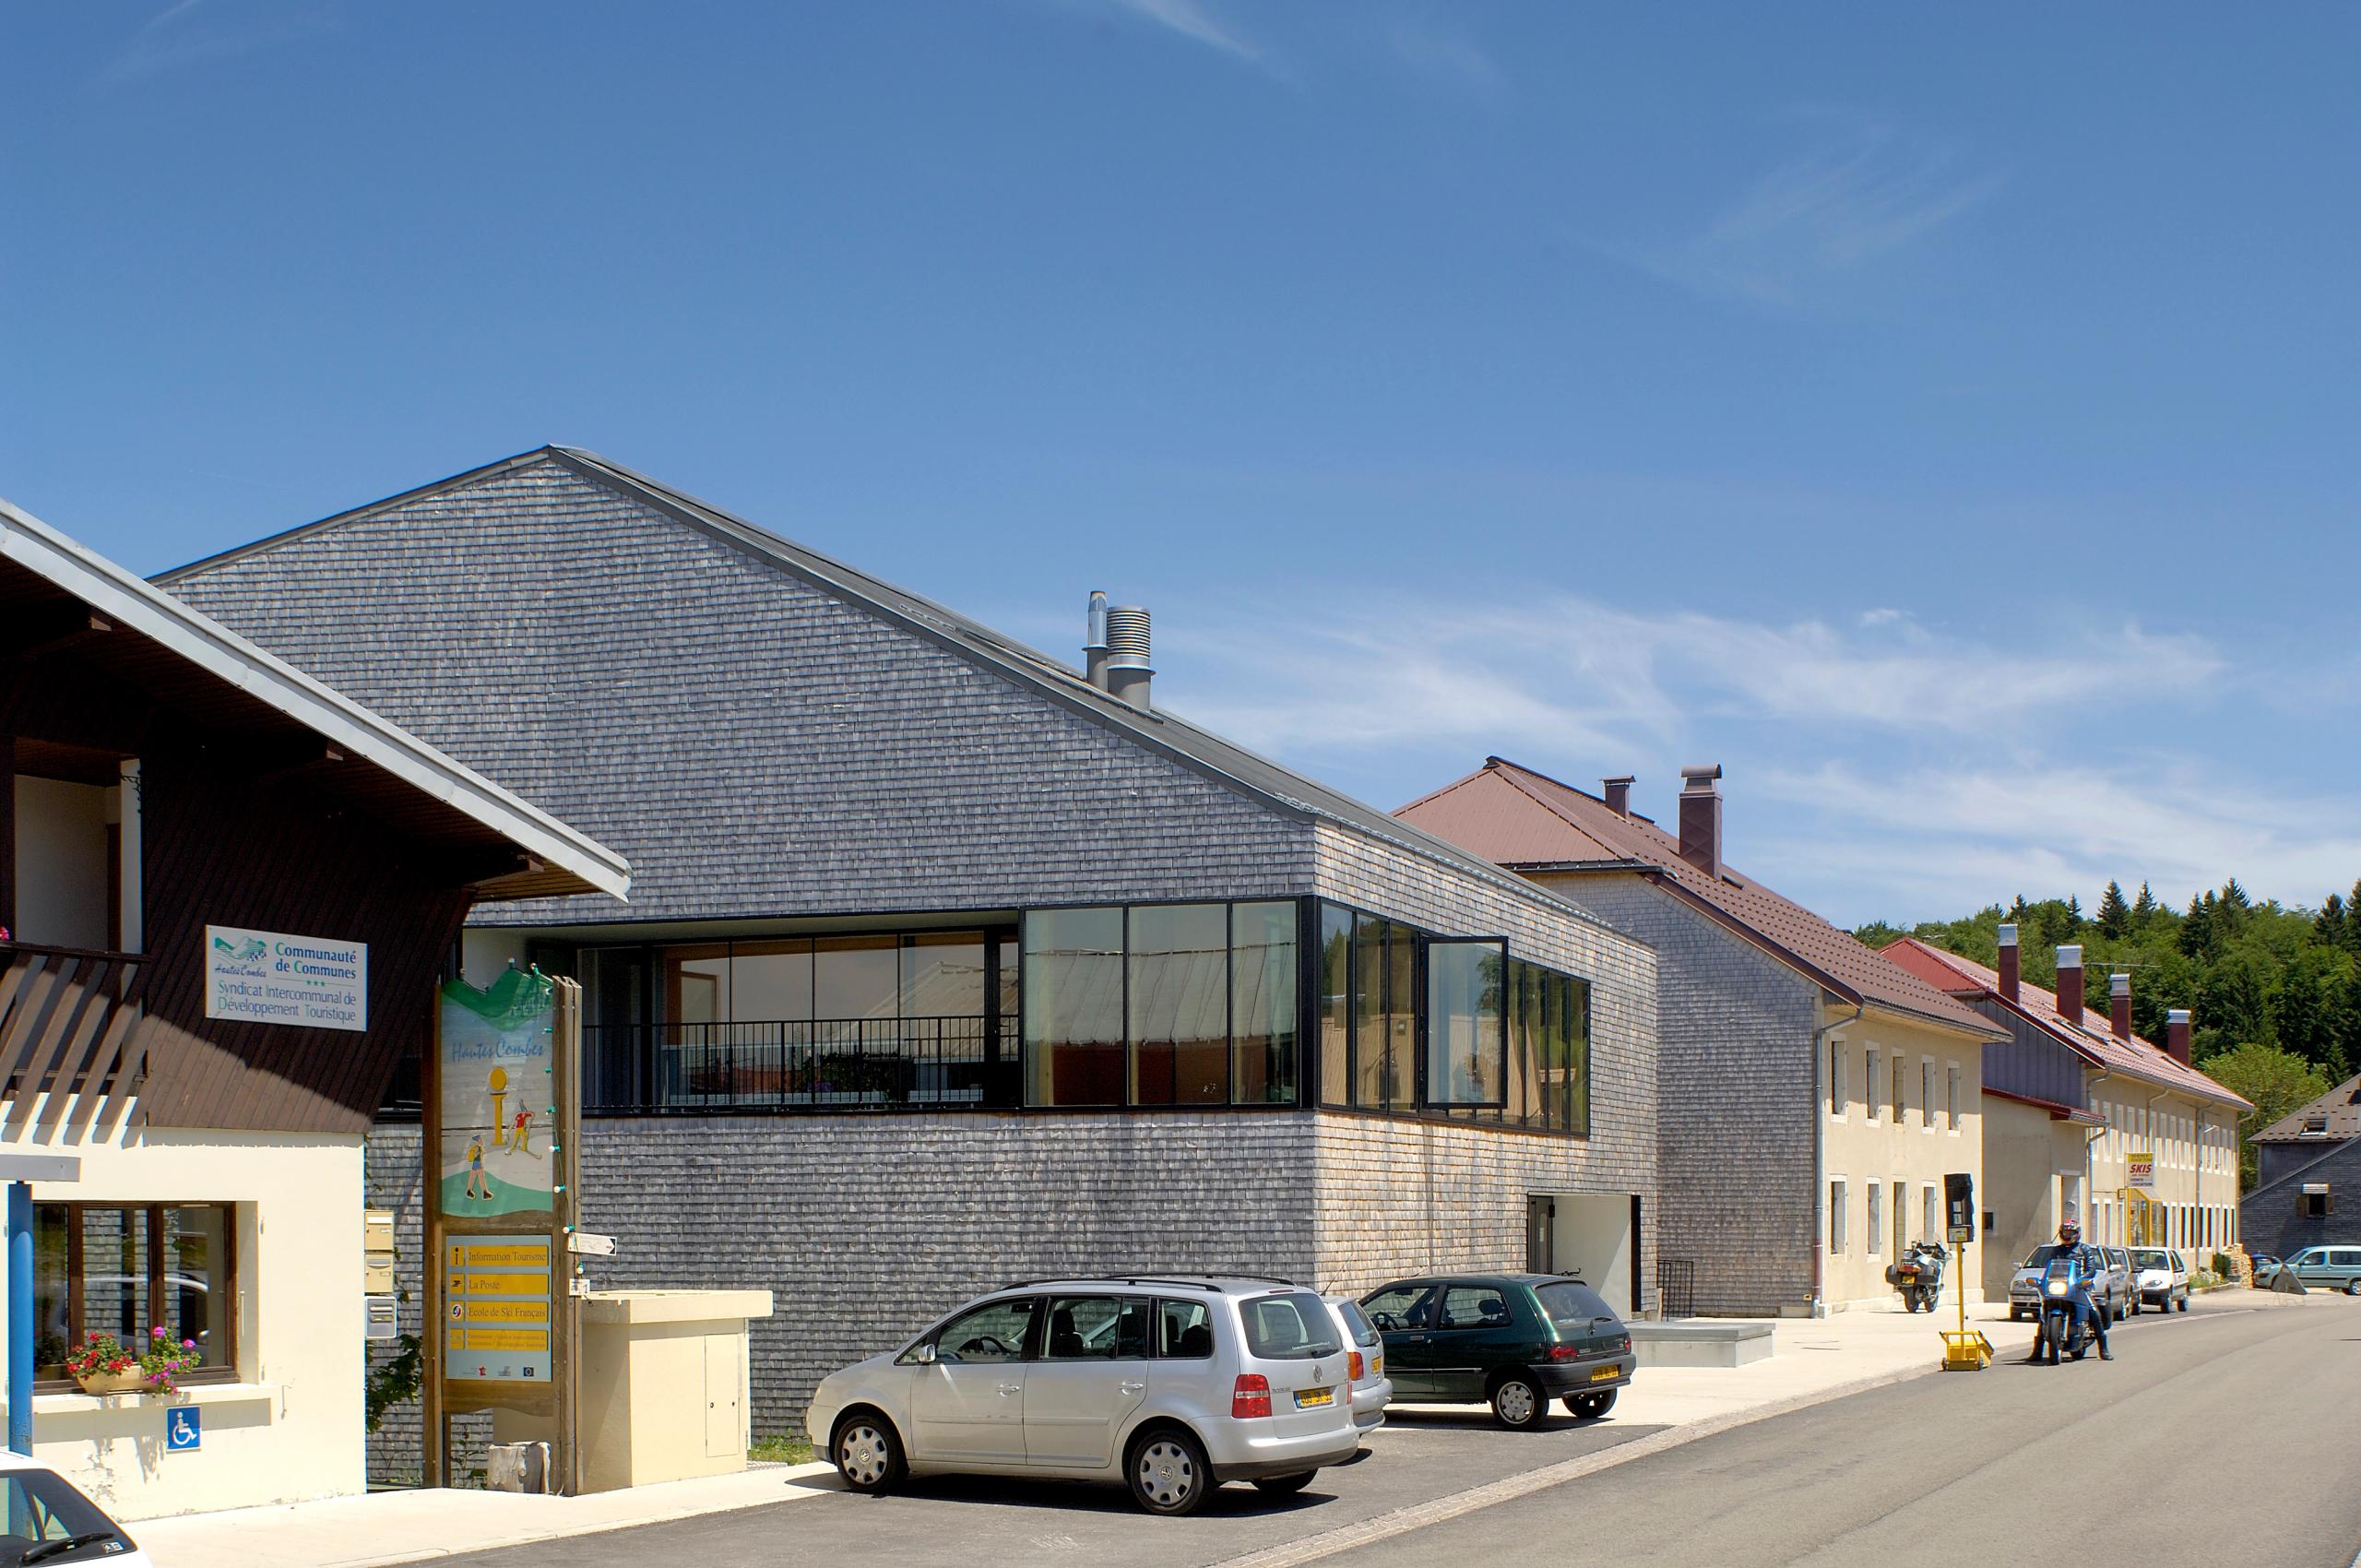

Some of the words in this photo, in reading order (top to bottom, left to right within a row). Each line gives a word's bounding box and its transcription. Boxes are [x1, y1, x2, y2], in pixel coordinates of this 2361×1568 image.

[276, 942, 356, 964] Communauté
[276, 958, 291, 973] de
[293, 960, 356, 980] Communes
[218, 980, 262, 997] Syndicat
[266, 984, 342, 1004] Intercommunal
[343, 992, 356, 1006] de
[218, 996, 300, 1017] Développement
[304, 1004, 356, 1025] Touristique
[452, 1041, 493, 1063] Hautes
[495, 1036, 544, 1058] Combes
[2130, 1164, 2152, 1173] SKIS
[469, 1252, 511, 1262] Information
[512, 1252, 546, 1262] Tourisme
[469, 1280, 478, 1289] La
[481, 1280, 500, 1289] Poste
[491, 1307, 499, 1317] de
[501, 1307, 513, 1317] Ski
[516, 1308, 546, 1319] Français
